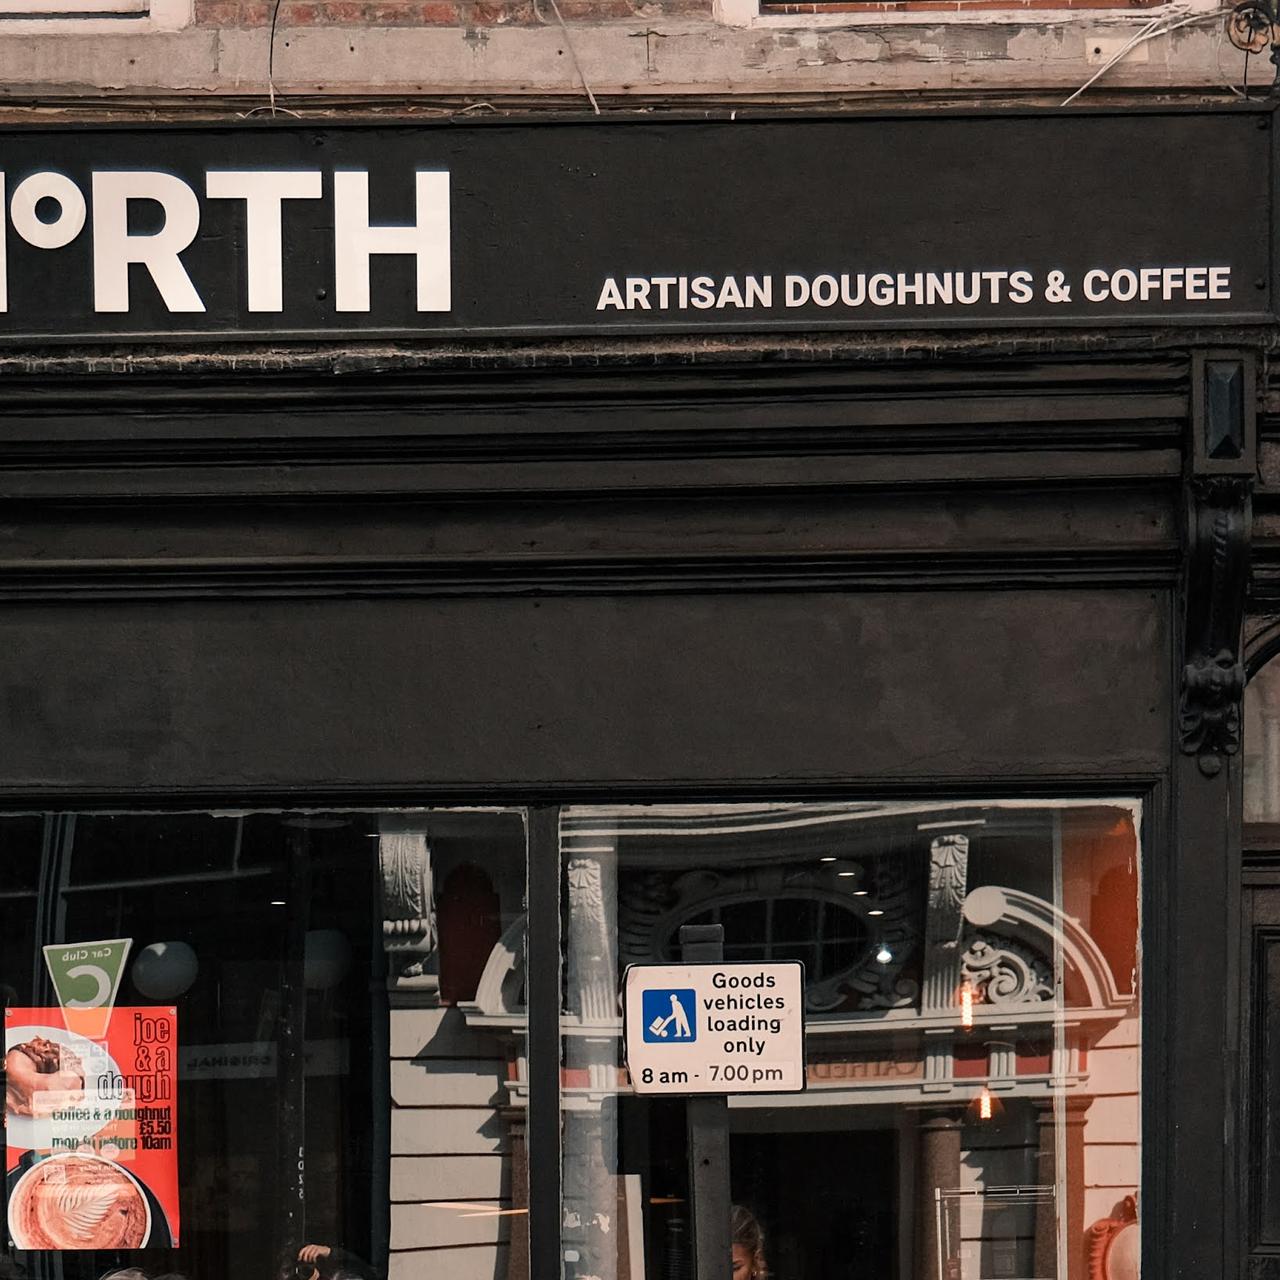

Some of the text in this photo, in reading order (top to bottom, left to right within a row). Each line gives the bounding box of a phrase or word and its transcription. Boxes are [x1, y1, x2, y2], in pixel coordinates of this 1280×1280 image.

[596, 266, 1232, 311] ARTISAN DOUGHNUTS & COFFEE
[712, 972, 776, 989] Goods
[704, 994, 785, 1011] vehicles
[134, 1012, 170, 1046] joe
[707, 1015, 781, 1034] loading
[723, 1037, 766, 1056] only
[135, 1045, 151, 1072] &
[155, 1045, 170, 1072] a
[97, 1070, 170, 1102] dough
[52, 1104, 171, 1122] coffee & a doughnut
[139, 1120, 171, 1136] £5.50
[141, 1134, 172, 1150] 10am
